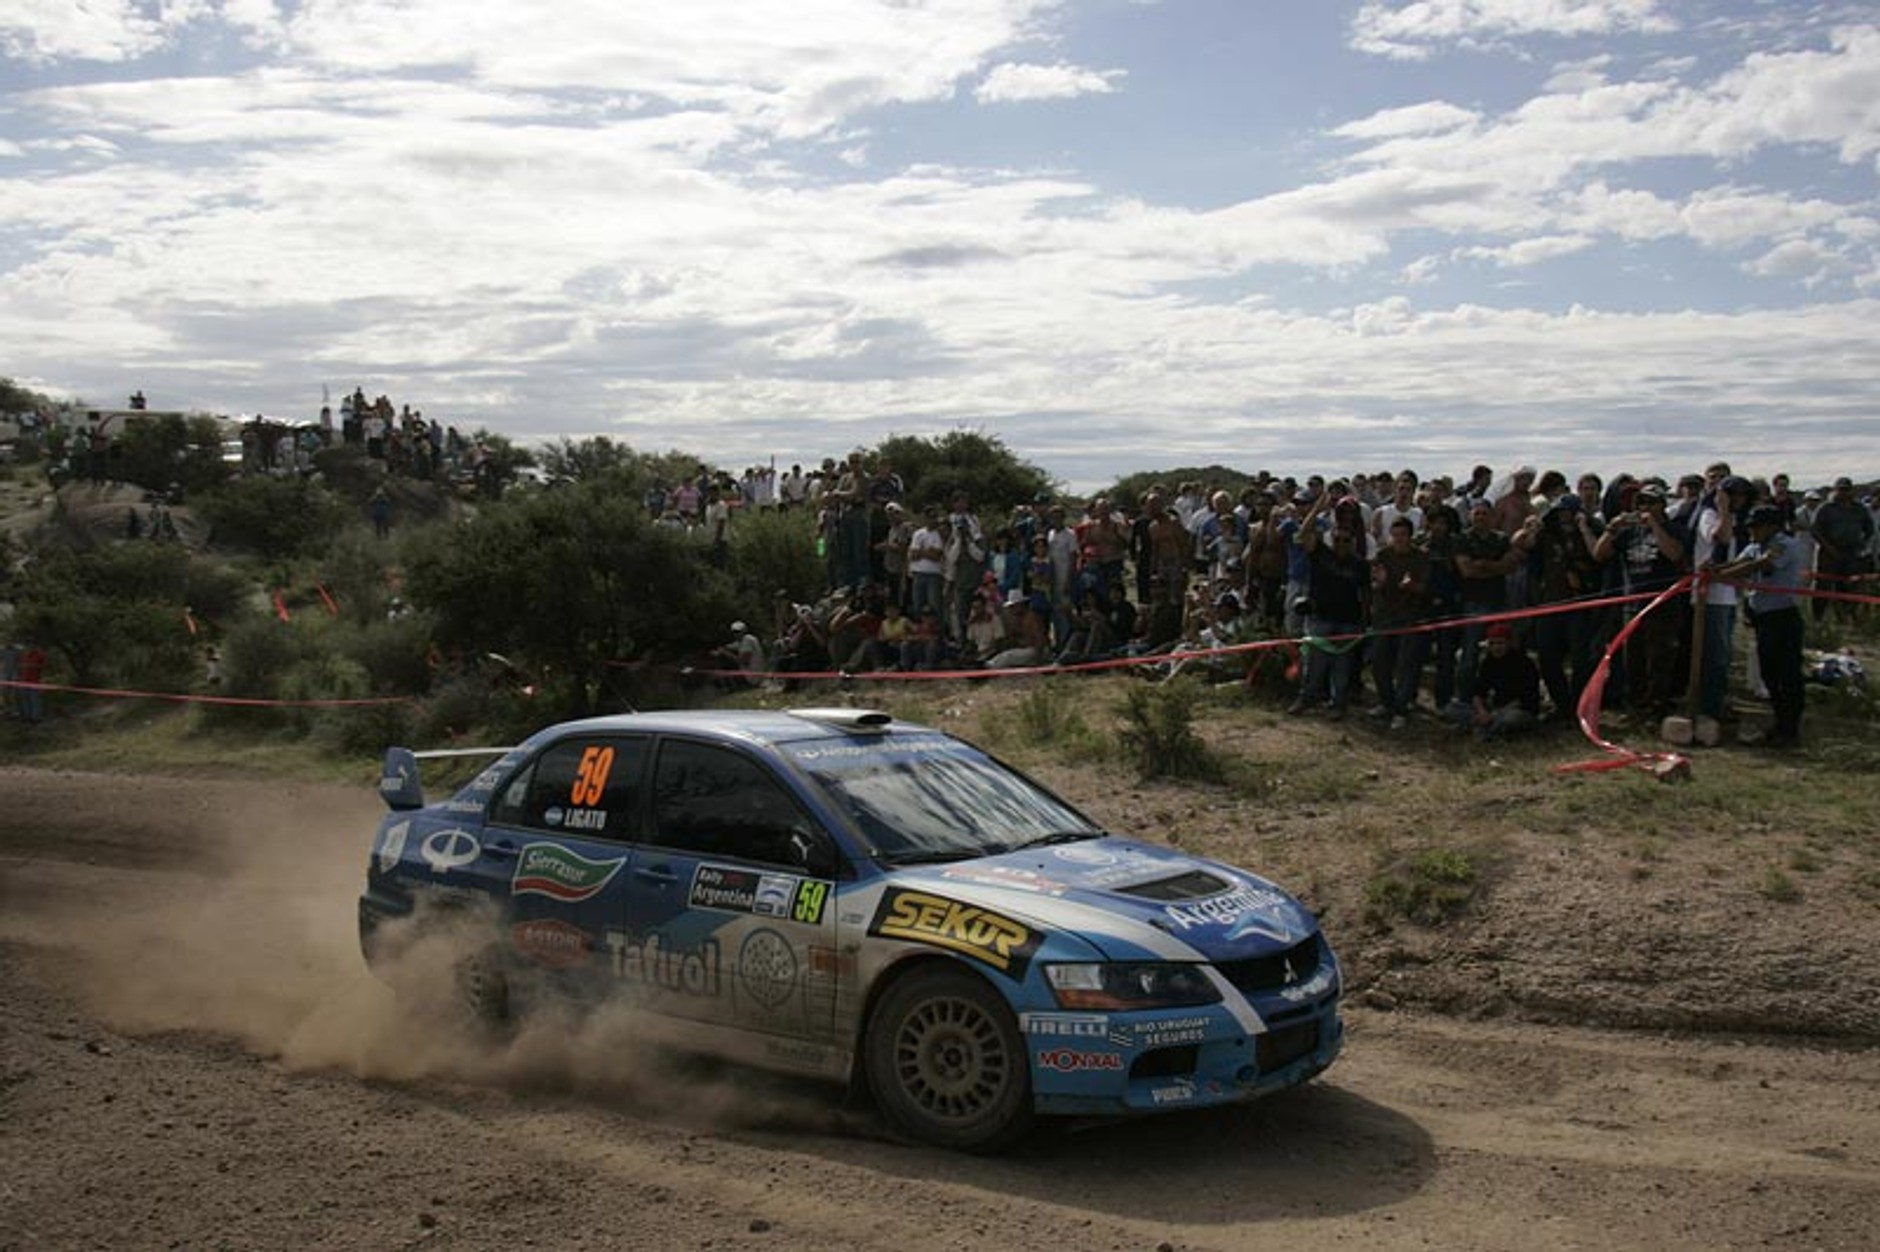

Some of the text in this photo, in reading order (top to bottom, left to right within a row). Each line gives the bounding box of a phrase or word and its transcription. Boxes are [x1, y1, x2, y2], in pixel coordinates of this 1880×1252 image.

[571, 746, 615, 806] 59
[564, 807, 608, 830] LIGATO
[693, 883, 753, 908] Argentina
[795, 881, 825, 922] 59
[1019, 1013, 1109, 1036] PIRELLI
